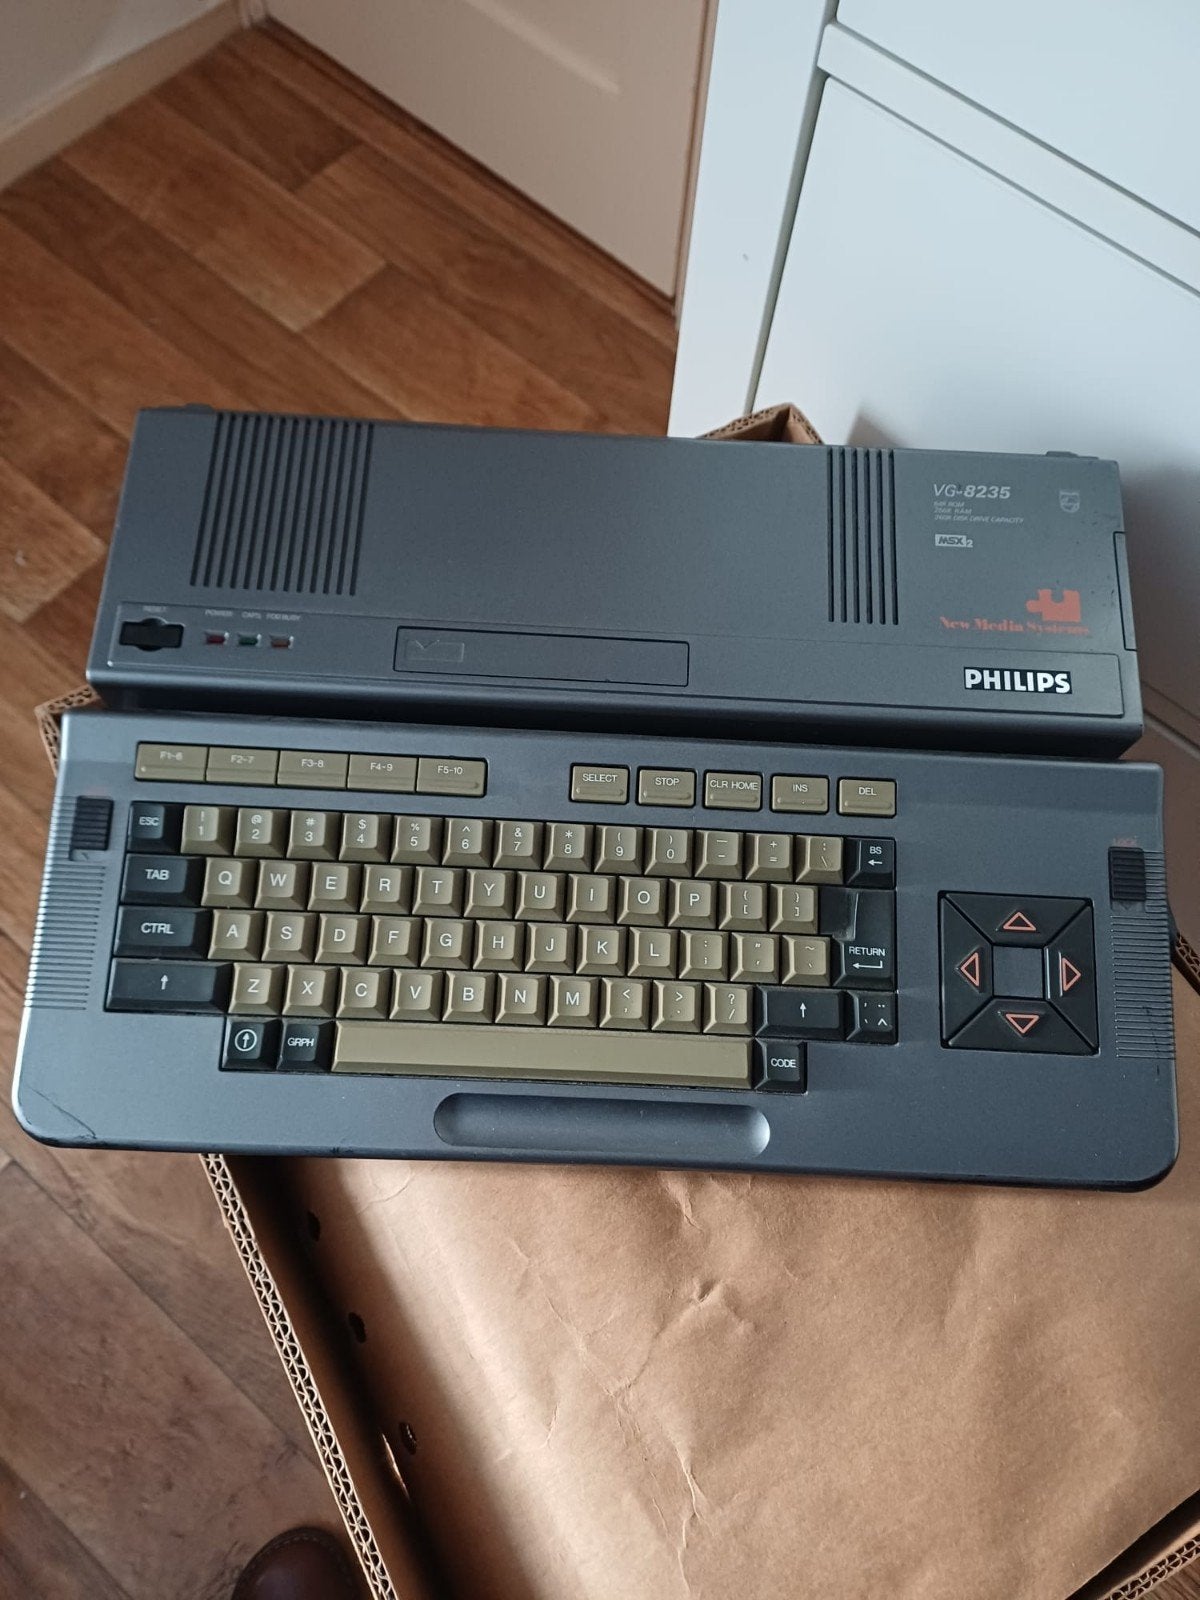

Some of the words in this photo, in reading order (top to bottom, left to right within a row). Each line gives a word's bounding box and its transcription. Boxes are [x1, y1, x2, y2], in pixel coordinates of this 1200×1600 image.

[933, 483, 1011, 499] VG-8235
[939, 616, 971, 630] New
[973, 618, 1025, 632] Media
[965, 669, 1071, 694] PHILIPS
[159, 751, 183, 761] F1-6
[230, 754, 255, 764] F2-7
[301, 758, 324, 768] F3-8
[370, 762, 393, 772] F4-9
[437, 765, 463, 775] F5-10
[582, 773, 618, 784] SELECT
[654, 777, 680, 787] STOP
[709, 779, 729, 789] CLR
[731, 781, 759, 791] HOME
[792, 784, 808, 793] INS
[858, 787, 877, 796] DEL
[139, 816, 160, 826] ESC
[199, 826, 204, 836] 1
[252, 829, 260, 839] 2
[304, 831, 313, 841] 3
[356, 834, 364, 843] 4
[410, 836, 418, 846] 5
[461, 839, 469, 849] 6
[513, 841, 522, 851] 7
[564, 843, 572, 854] 8
[615, 846, 624, 857] 9
[869, 846, 882, 855] BS
[666, 849, 675, 859] 0
[145, 869, 170, 881] TAB
[218, 871, 233, 886] Q
[270, 873, 287, 887] W
[326, 876, 337, 890] E
[379, 879, 391, 892] R
[432, 880, 443, 894] T
[483, 883, 495, 896] Y
[534, 885, 546, 898] U
[590, 888, 594, 902] I
[637, 890, 651, 904] O
[689, 893, 700, 907] P
[141, 922, 174, 935] CTRL
[226, 924, 239, 937] A
[281, 926, 292, 939] S
[334, 929, 346, 942] D
[388, 930, 399, 944] F
[439, 934, 452, 947] G
[492, 936, 504, 949] H
[545, 938, 554, 951] J
[597, 941, 608, 955] K
[649, 943, 660, 957] L
[849, 946, 885, 957] RETURN
[247, 979, 260, 992] Z
[302, 981, 314, 994] X
[355, 983, 368, 997] C
[410, 985, 422, 999] V
[463, 987, 475, 1001] B
[514, 990, 527, 1003] N
[566, 991, 580, 1005] M
[287, 1037, 315, 1047] GRPH
[770, 1058, 796, 1068] CODE
